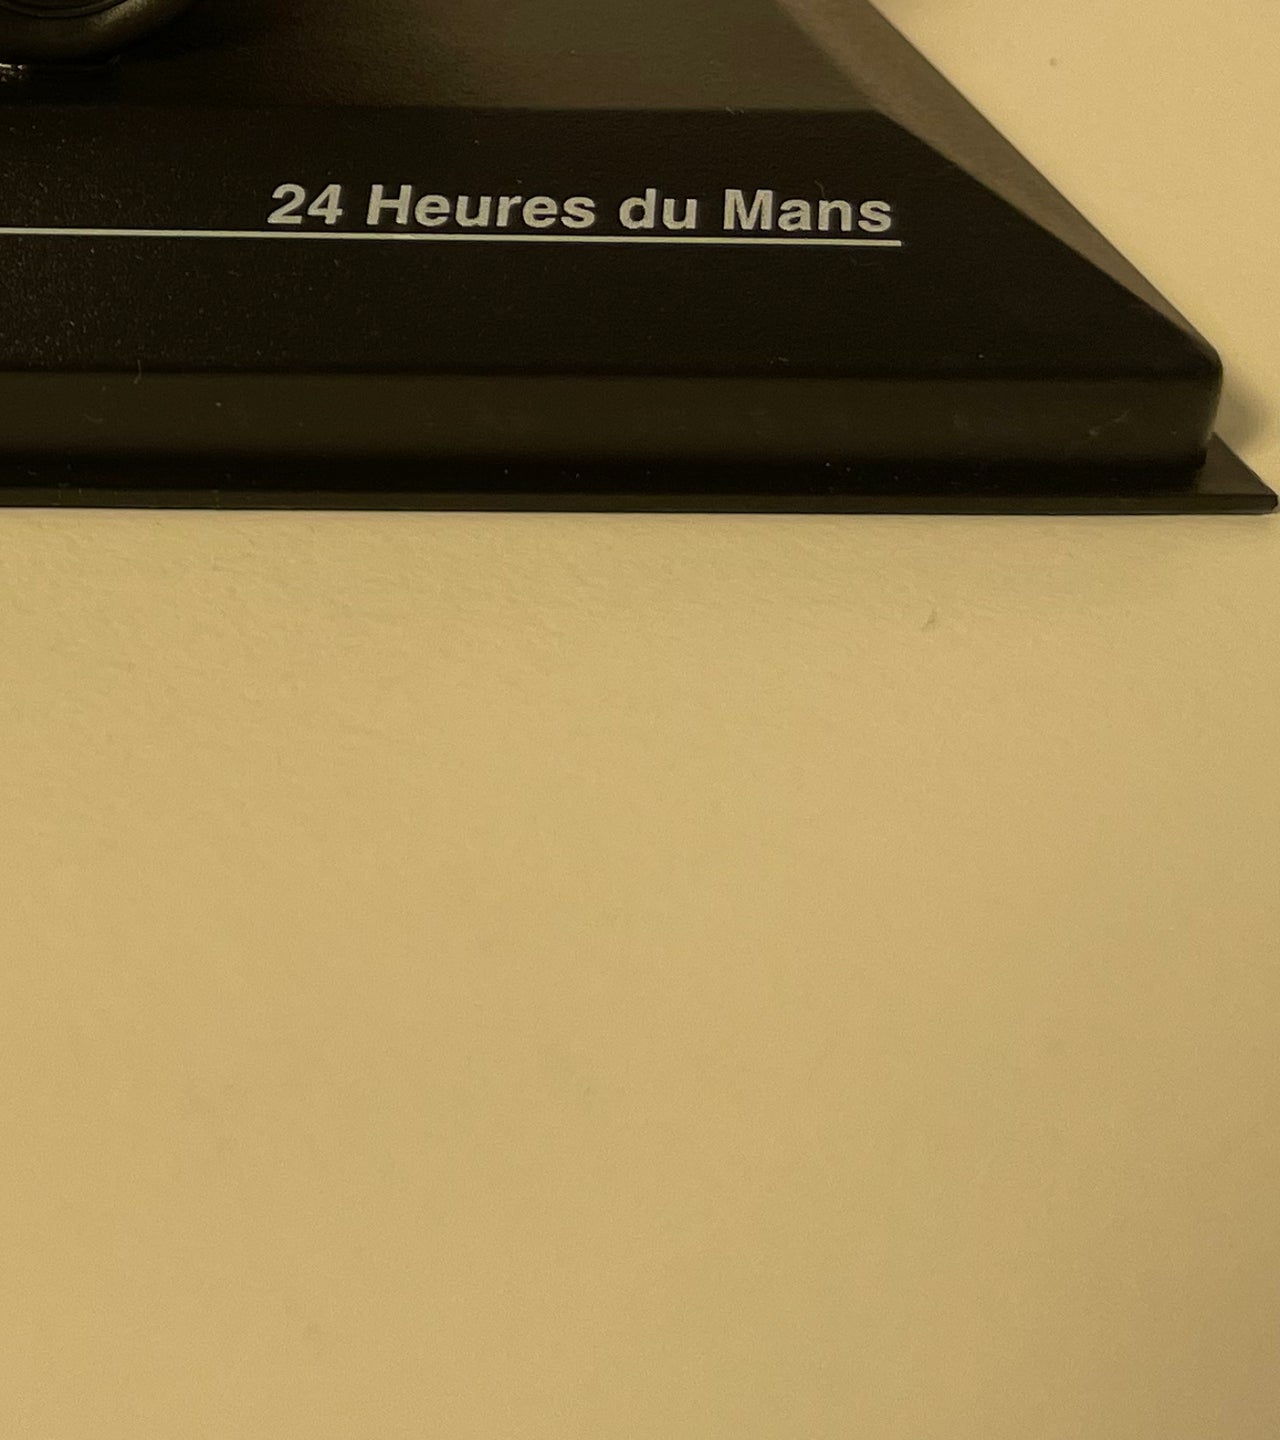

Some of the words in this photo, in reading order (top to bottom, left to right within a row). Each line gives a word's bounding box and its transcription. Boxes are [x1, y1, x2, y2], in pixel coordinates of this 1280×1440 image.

[266, 183, 343, 226] 24
[366, 183, 596, 230] Heures
[618, 188, 698, 230] du
[722, 189, 893, 233] Mans
